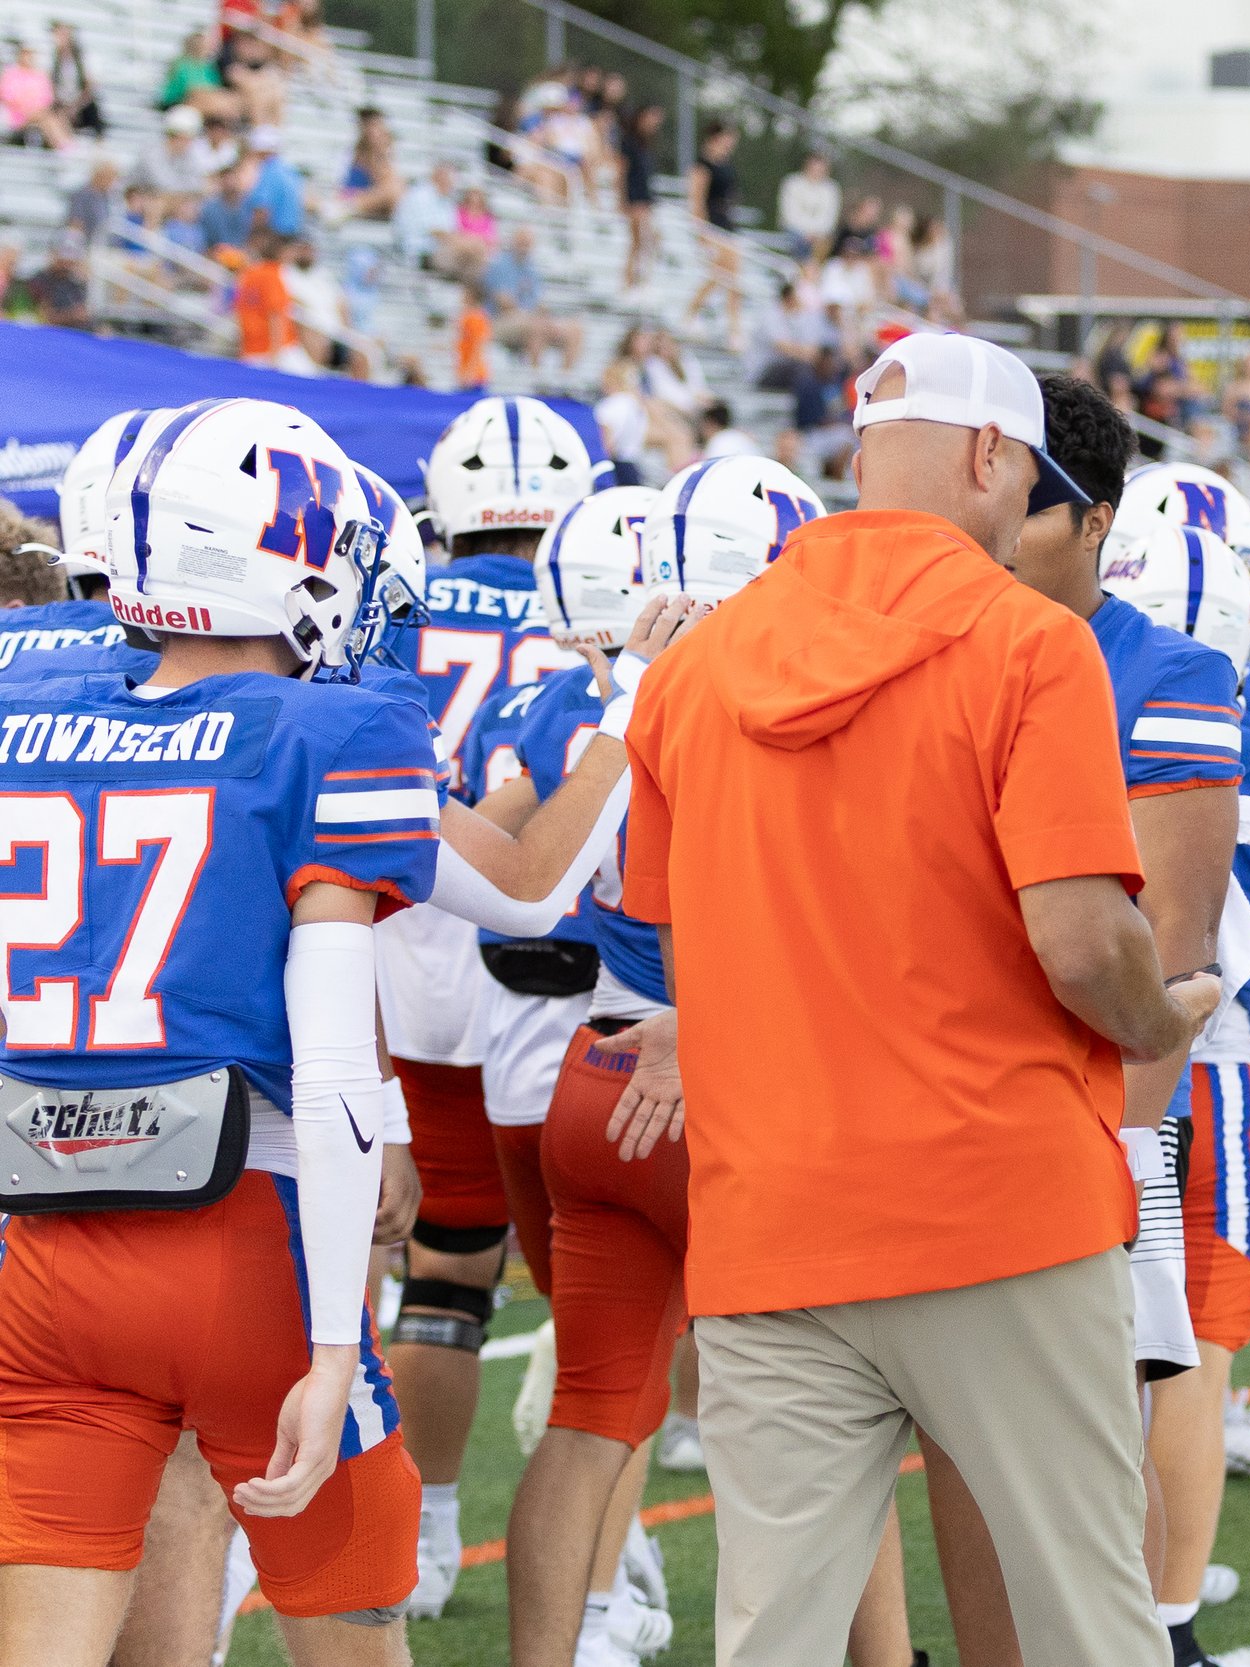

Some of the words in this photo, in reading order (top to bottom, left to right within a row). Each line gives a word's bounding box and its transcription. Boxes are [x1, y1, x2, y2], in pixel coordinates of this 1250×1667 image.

[256, 447, 344, 572] N
[481, 509, 556, 524] Riddell
[1175, 480, 1228, 543] N
[111, 595, 212, 632] Riddell
[0, 711, 235, 763] TOWNSEND
[0, 785, 216, 1050] 27
